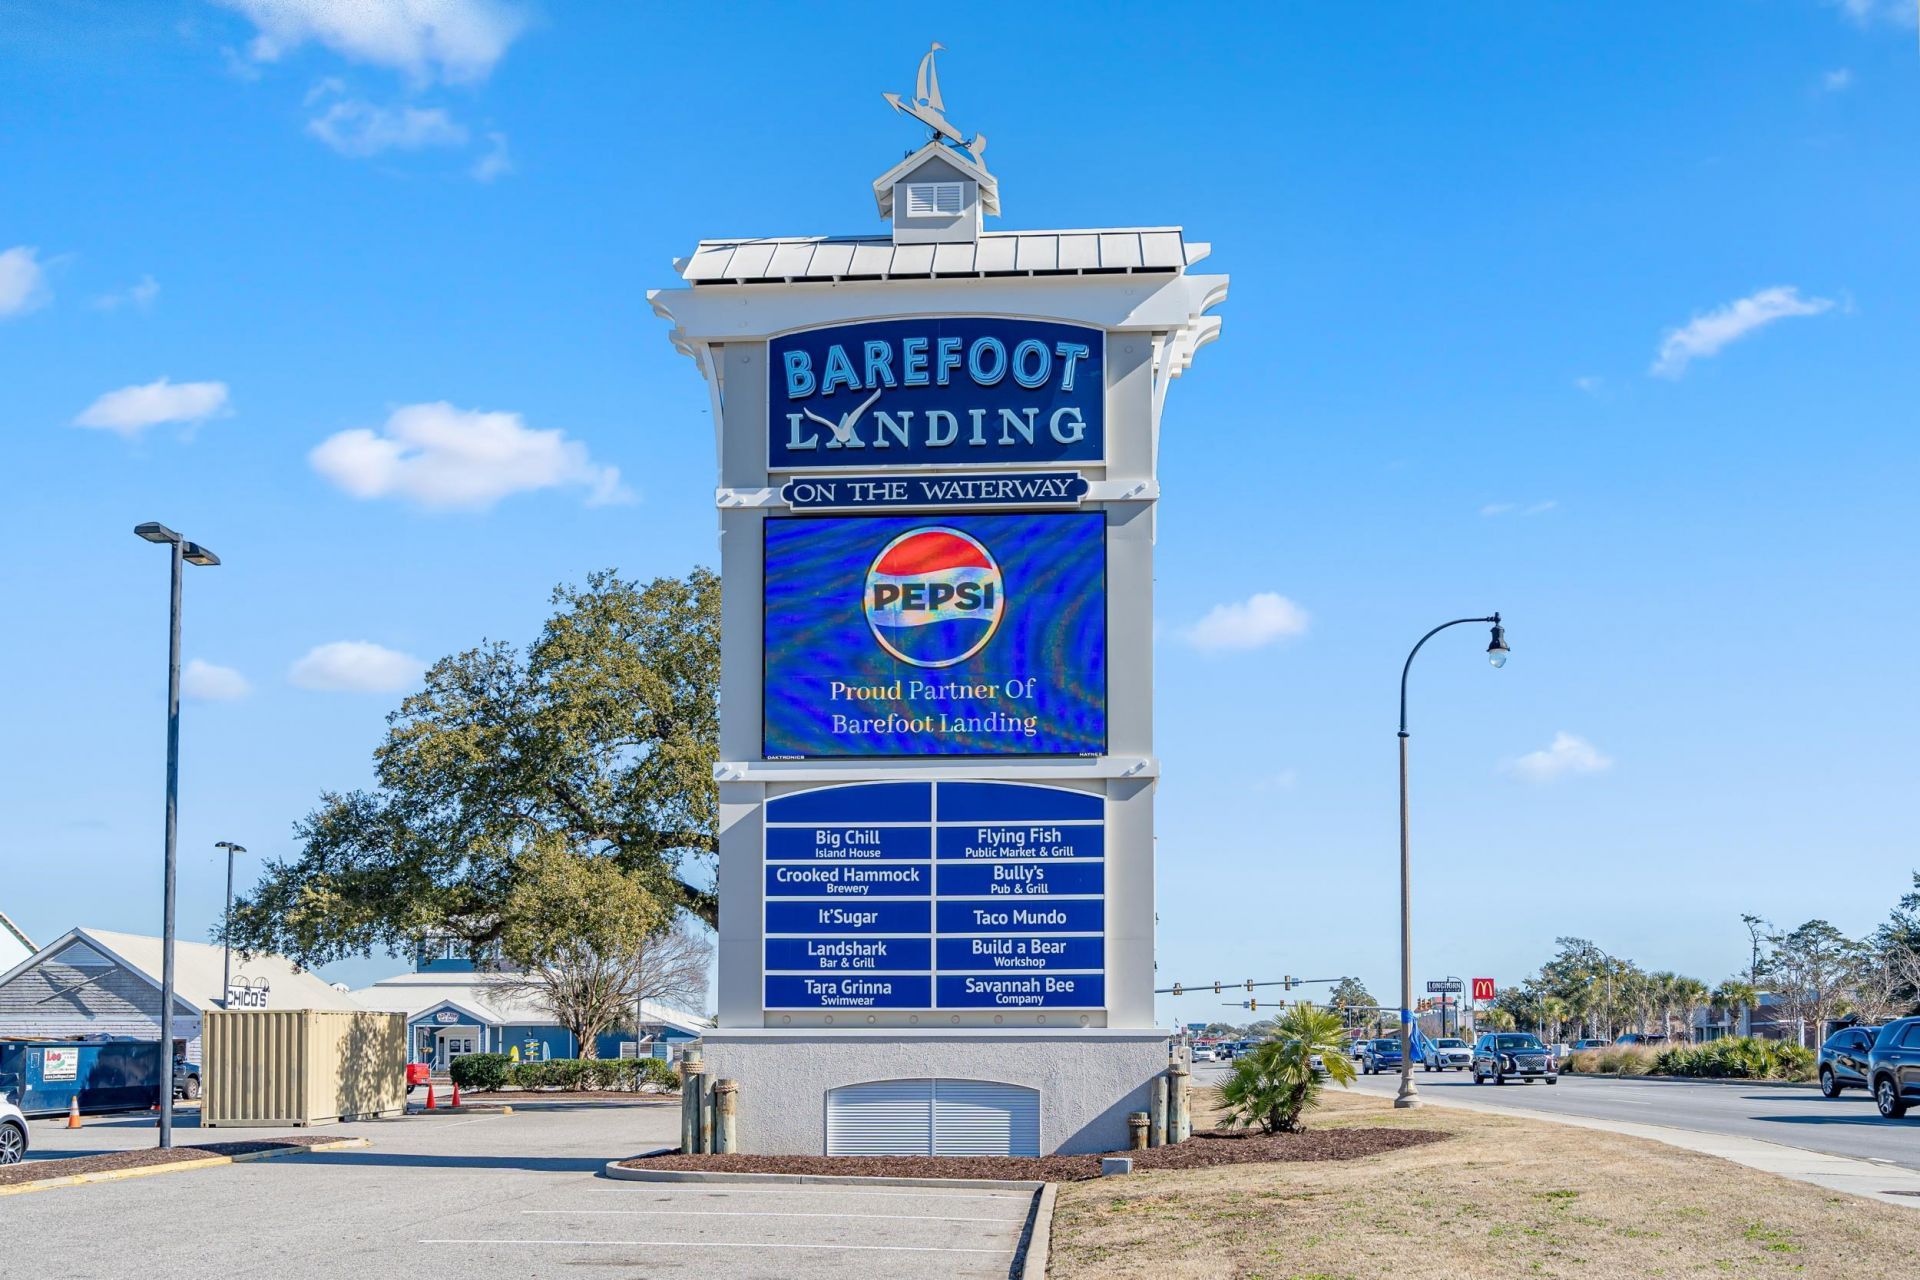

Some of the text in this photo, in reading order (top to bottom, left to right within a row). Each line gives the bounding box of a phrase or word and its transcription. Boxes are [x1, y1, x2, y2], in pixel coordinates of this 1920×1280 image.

[783, 336, 1090, 399] BAREFOOT
[785, 406, 1087, 450] LANDING
[793, 478, 1074, 502] ON THE WATERWAY
[873, 581, 995, 612] PEPSI
[830, 678, 1037, 701] Proud Partner Of
[831, 711, 1038, 737] Barefoot Landing
[816, 829, 880, 848] Big Chill
[978, 827, 1062, 847] Flying Fish
[815, 848, 881, 858] Island House
[965, 846, 1074, 858] Public Market & Grill
[776, 867, 920, 882] Crooked Hammock
[993, 865, 1044, 882] Bully's
[826, 883, 869, 895] Brewery
[991, 882, 1049, 894] Pub & Grill
[973, 909, 1067, 925] Taco Mundo
[808, 941, 887, 956] Landshark
[972, 938, 1067, 954] Build a Bear
[820, 957, 875, 968] Bar & Grill
[993, 956, 1046, 969] Workshop
[805, 979, 892, 995] Tara Grinna
[965, 977, 1075, 993] Savannah Bee
[228, 990, 267, 1008] CHICO'S
[821, 994, 875, 1006] Swimwear
[995, 993, 1044, 1006] Company
